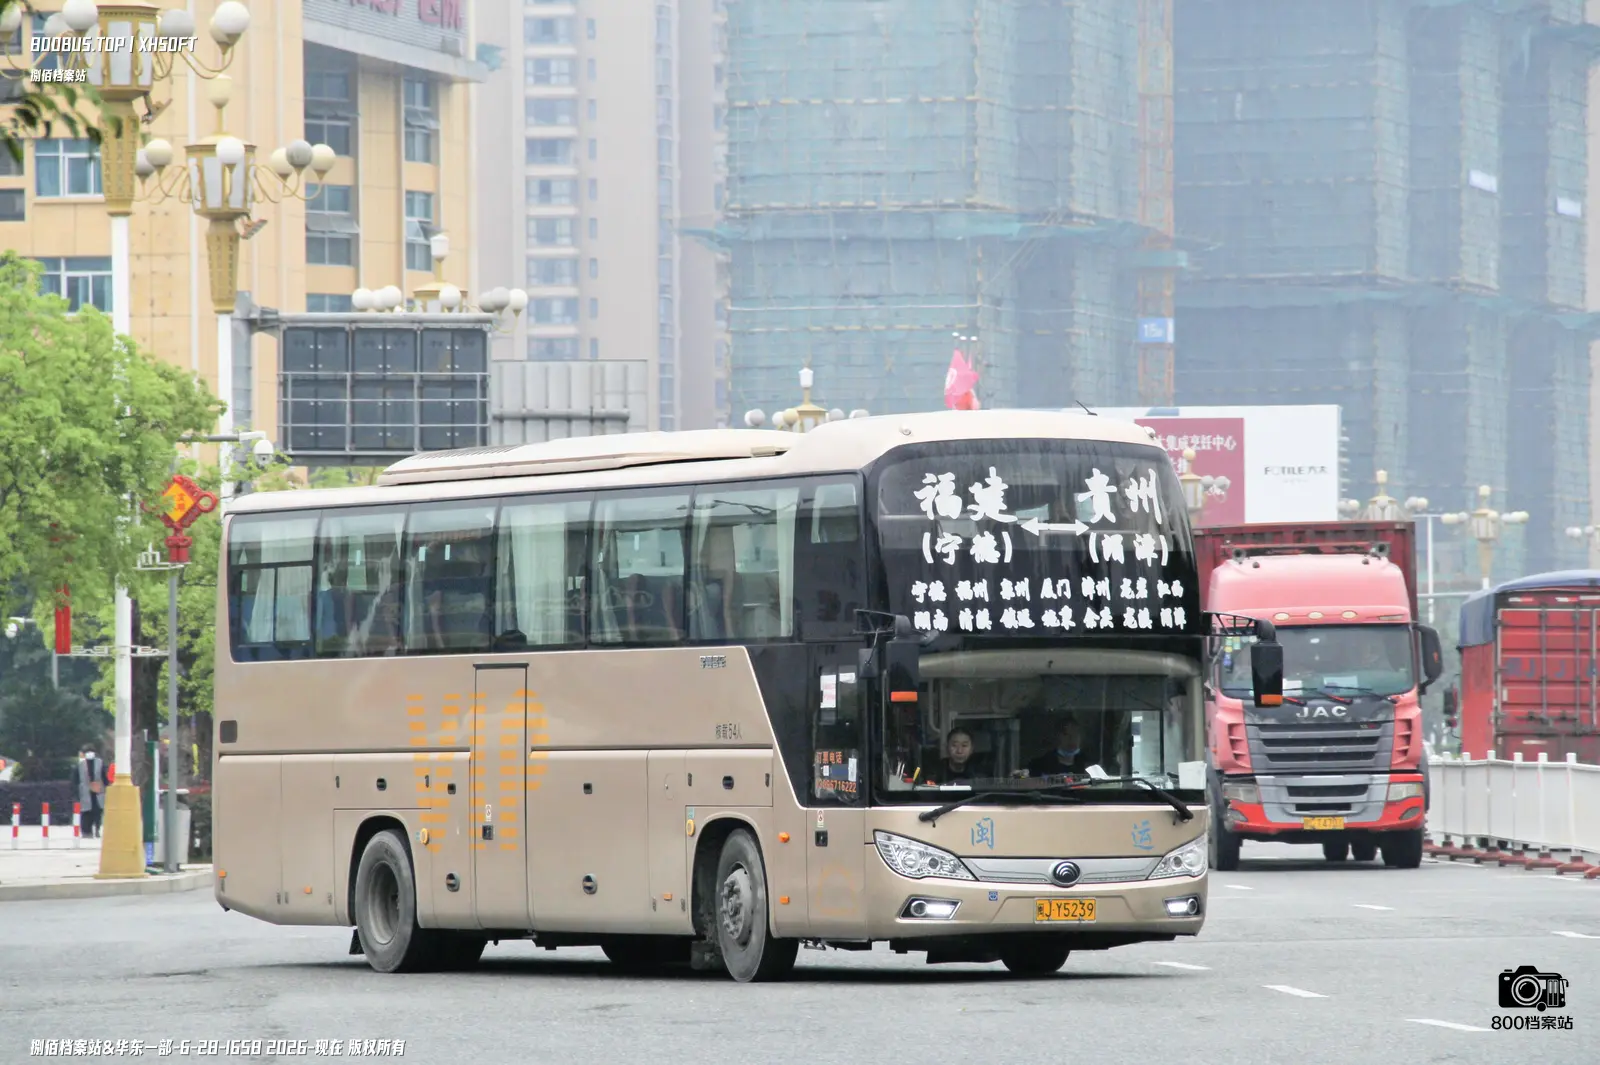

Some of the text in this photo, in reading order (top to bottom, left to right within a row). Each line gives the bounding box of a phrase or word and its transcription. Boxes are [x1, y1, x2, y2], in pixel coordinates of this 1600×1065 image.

[913, 466, 1163, 525] 福建 贵州
[911, 580, 947, 603] 宁德
[955, 578, 989, 602] 福州
[1041, 577, 1071, 599] 厦门
[1296, 706, 1347, 718] JAC
[971, 817, 1155, 850] 闽 运
